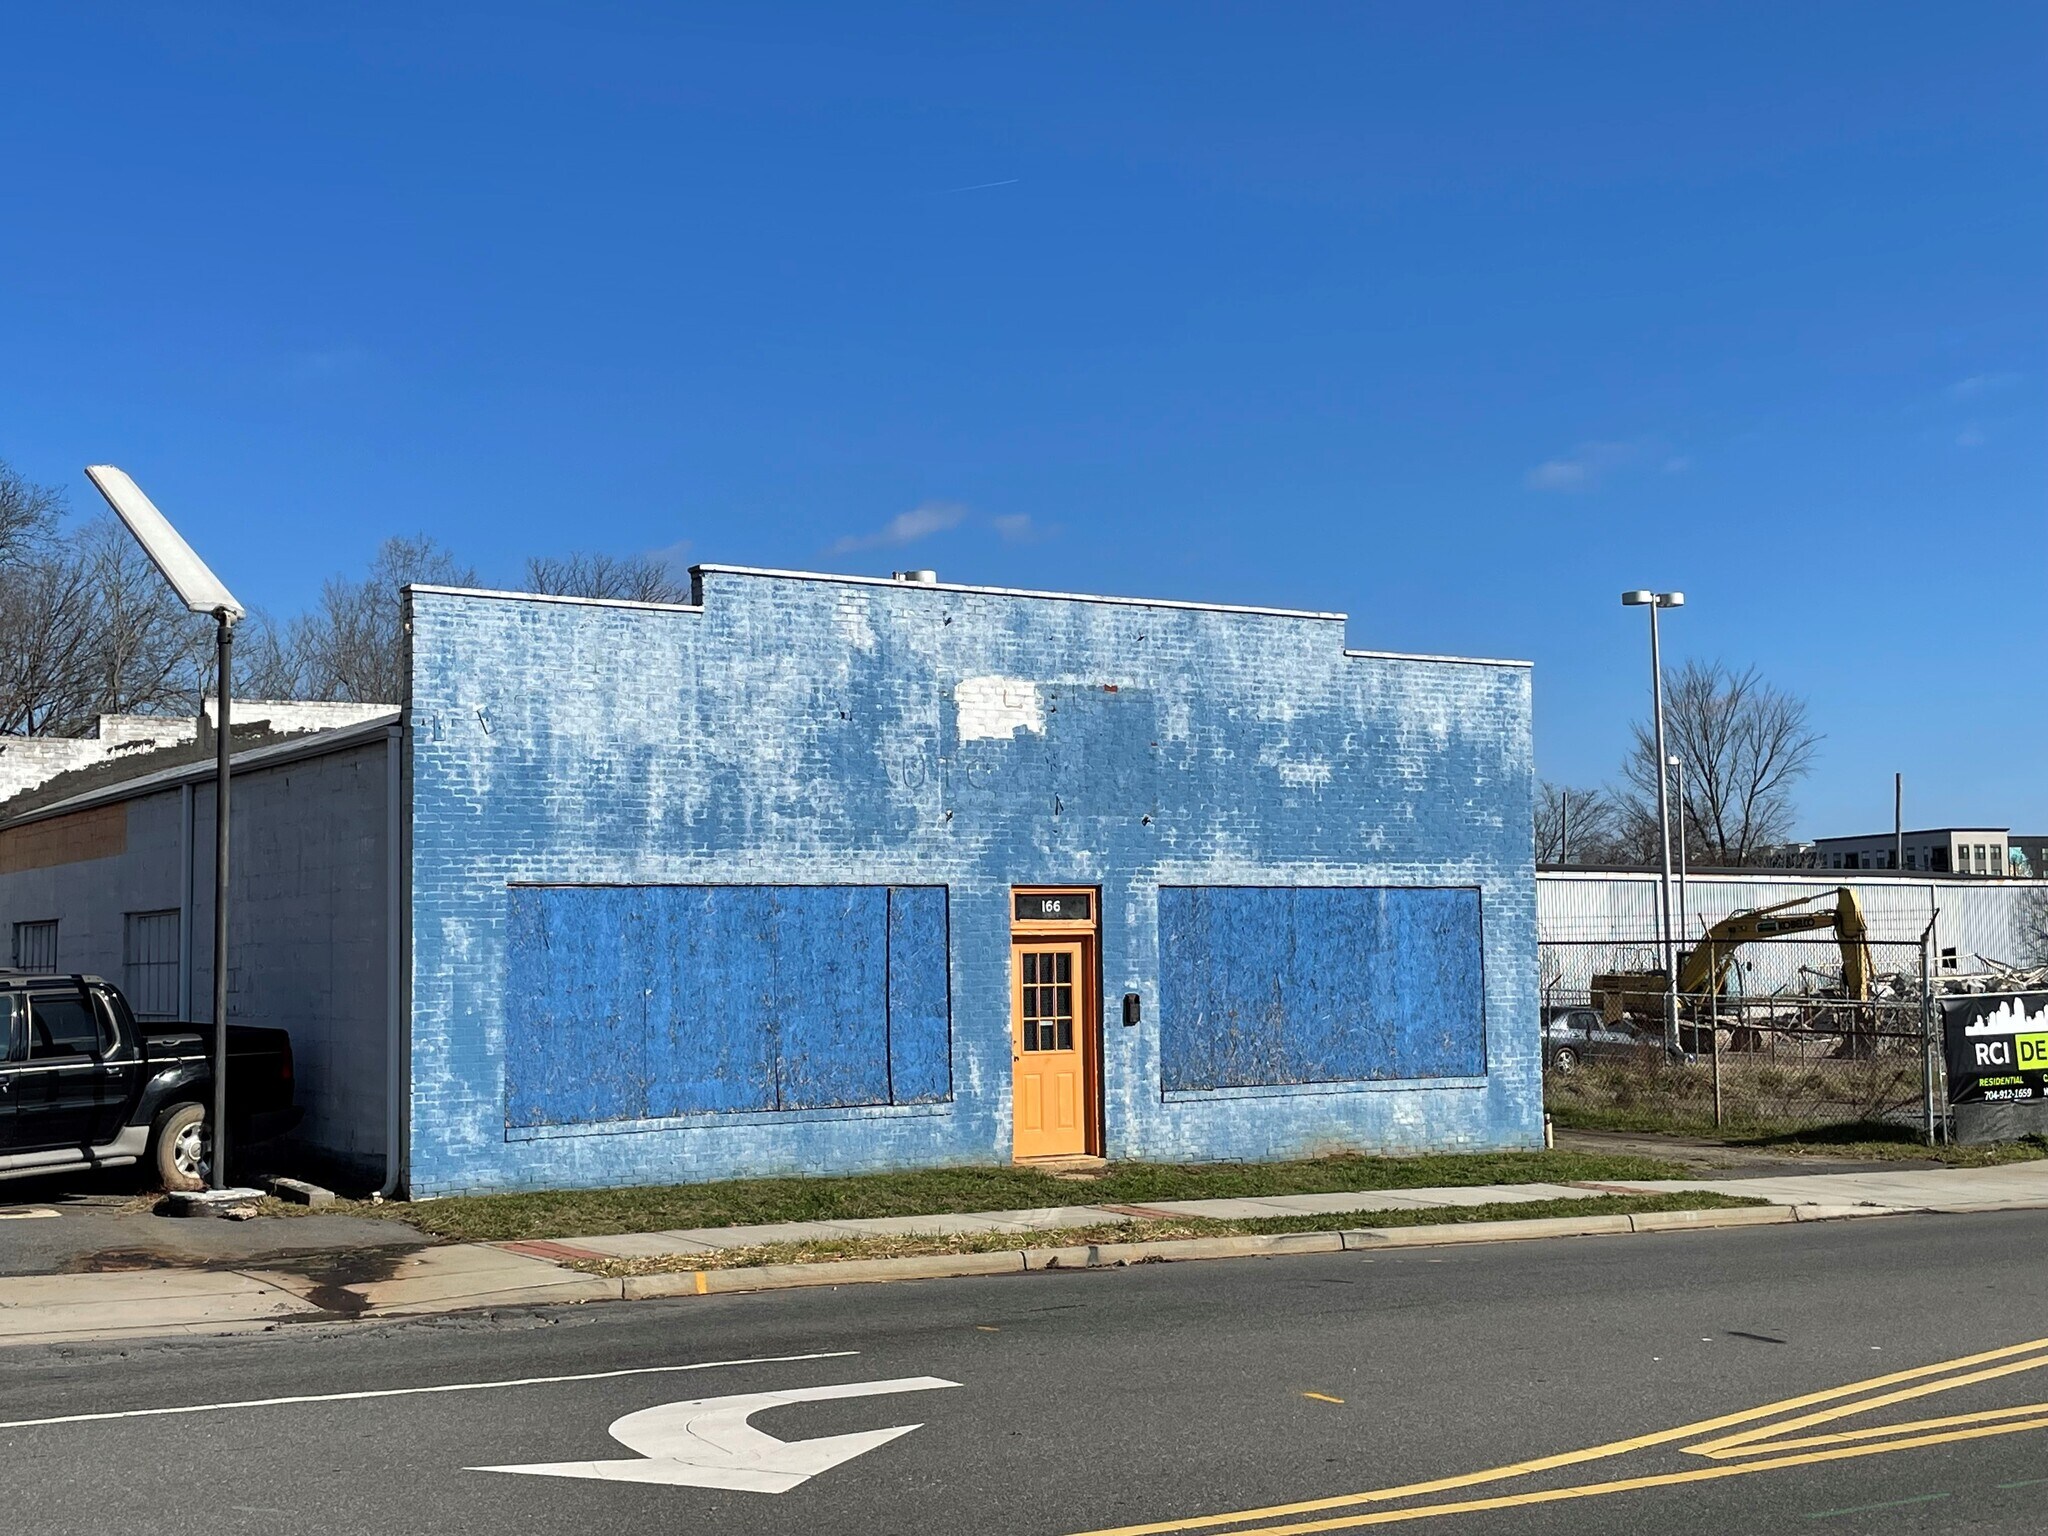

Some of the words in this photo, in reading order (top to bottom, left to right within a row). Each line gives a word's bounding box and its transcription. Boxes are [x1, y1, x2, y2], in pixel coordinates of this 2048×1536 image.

[1041, 900, 1061, 913] 166
[1974, 1041, 2010, 1066] RCI
[1978, 1075, 2024, 1087] RESIDENTIAL
[1983, 1088, 2033, 1101] 704-912-1659
